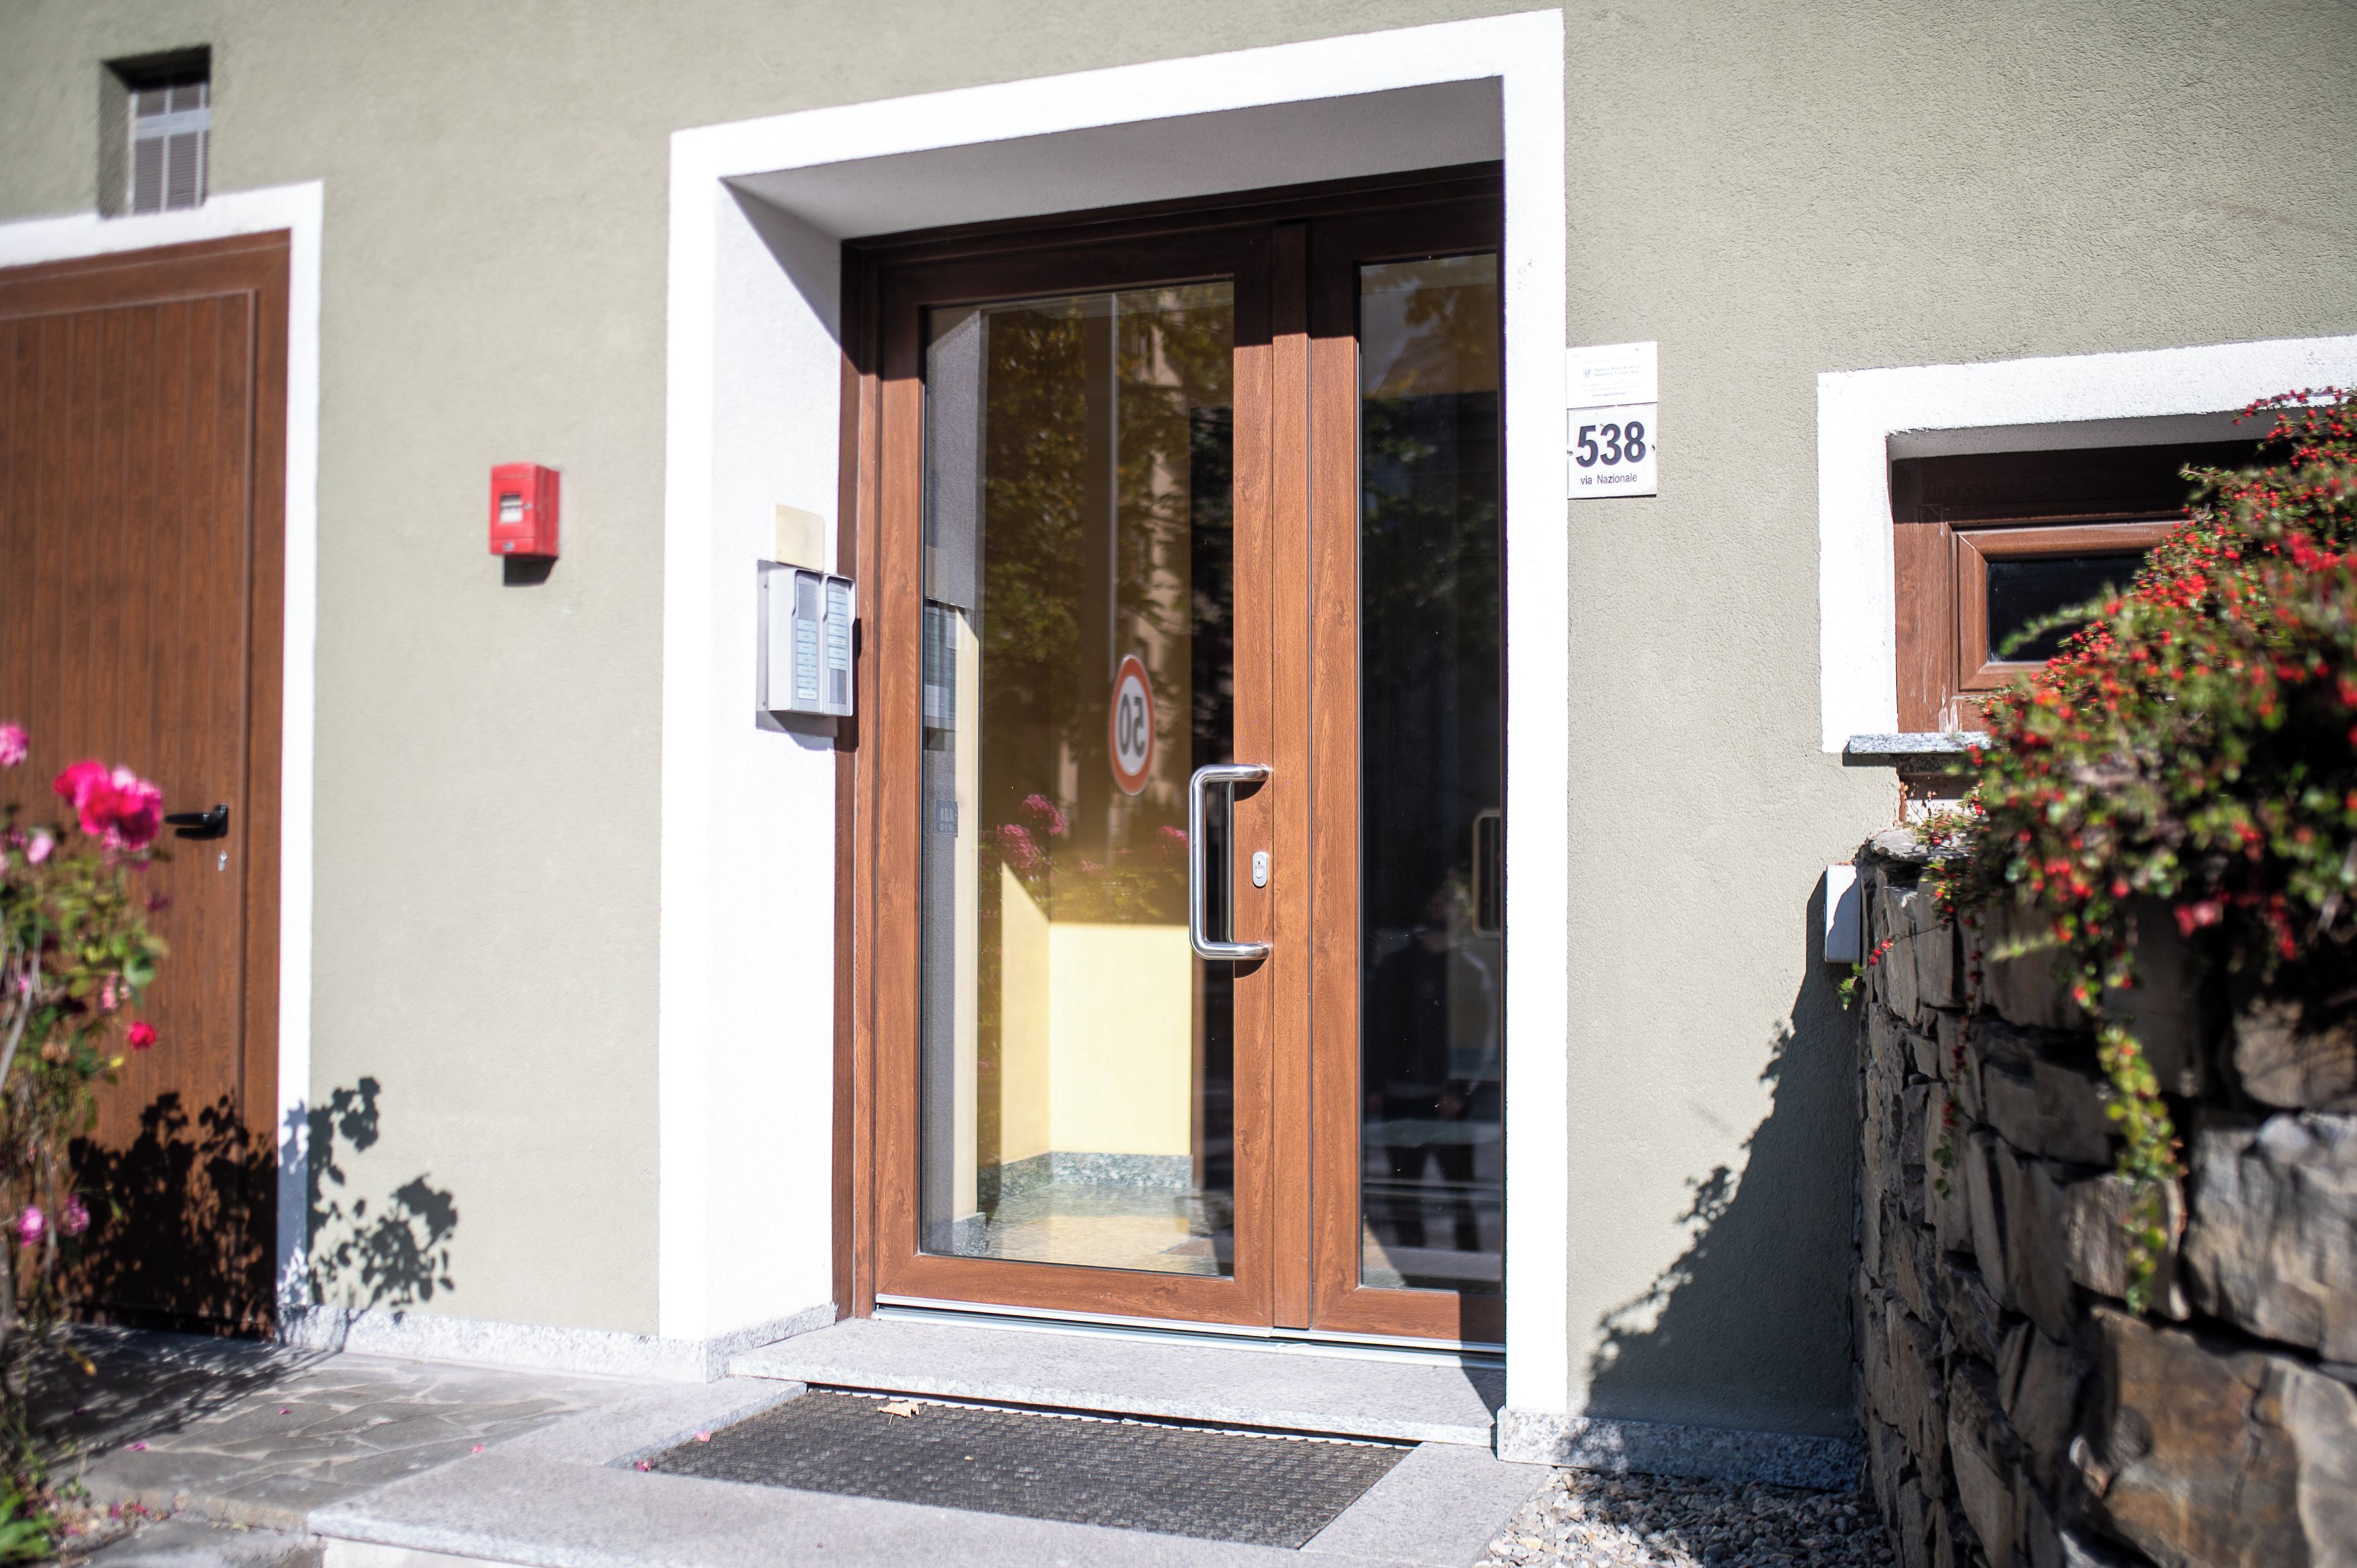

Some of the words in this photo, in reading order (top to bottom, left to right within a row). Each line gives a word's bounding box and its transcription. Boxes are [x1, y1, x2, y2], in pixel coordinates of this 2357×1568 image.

[1576, 421, 1646, 468] 538
[1581, 475, 1592, 485] via
[1596, 473, 1637, 484] Nazionale
